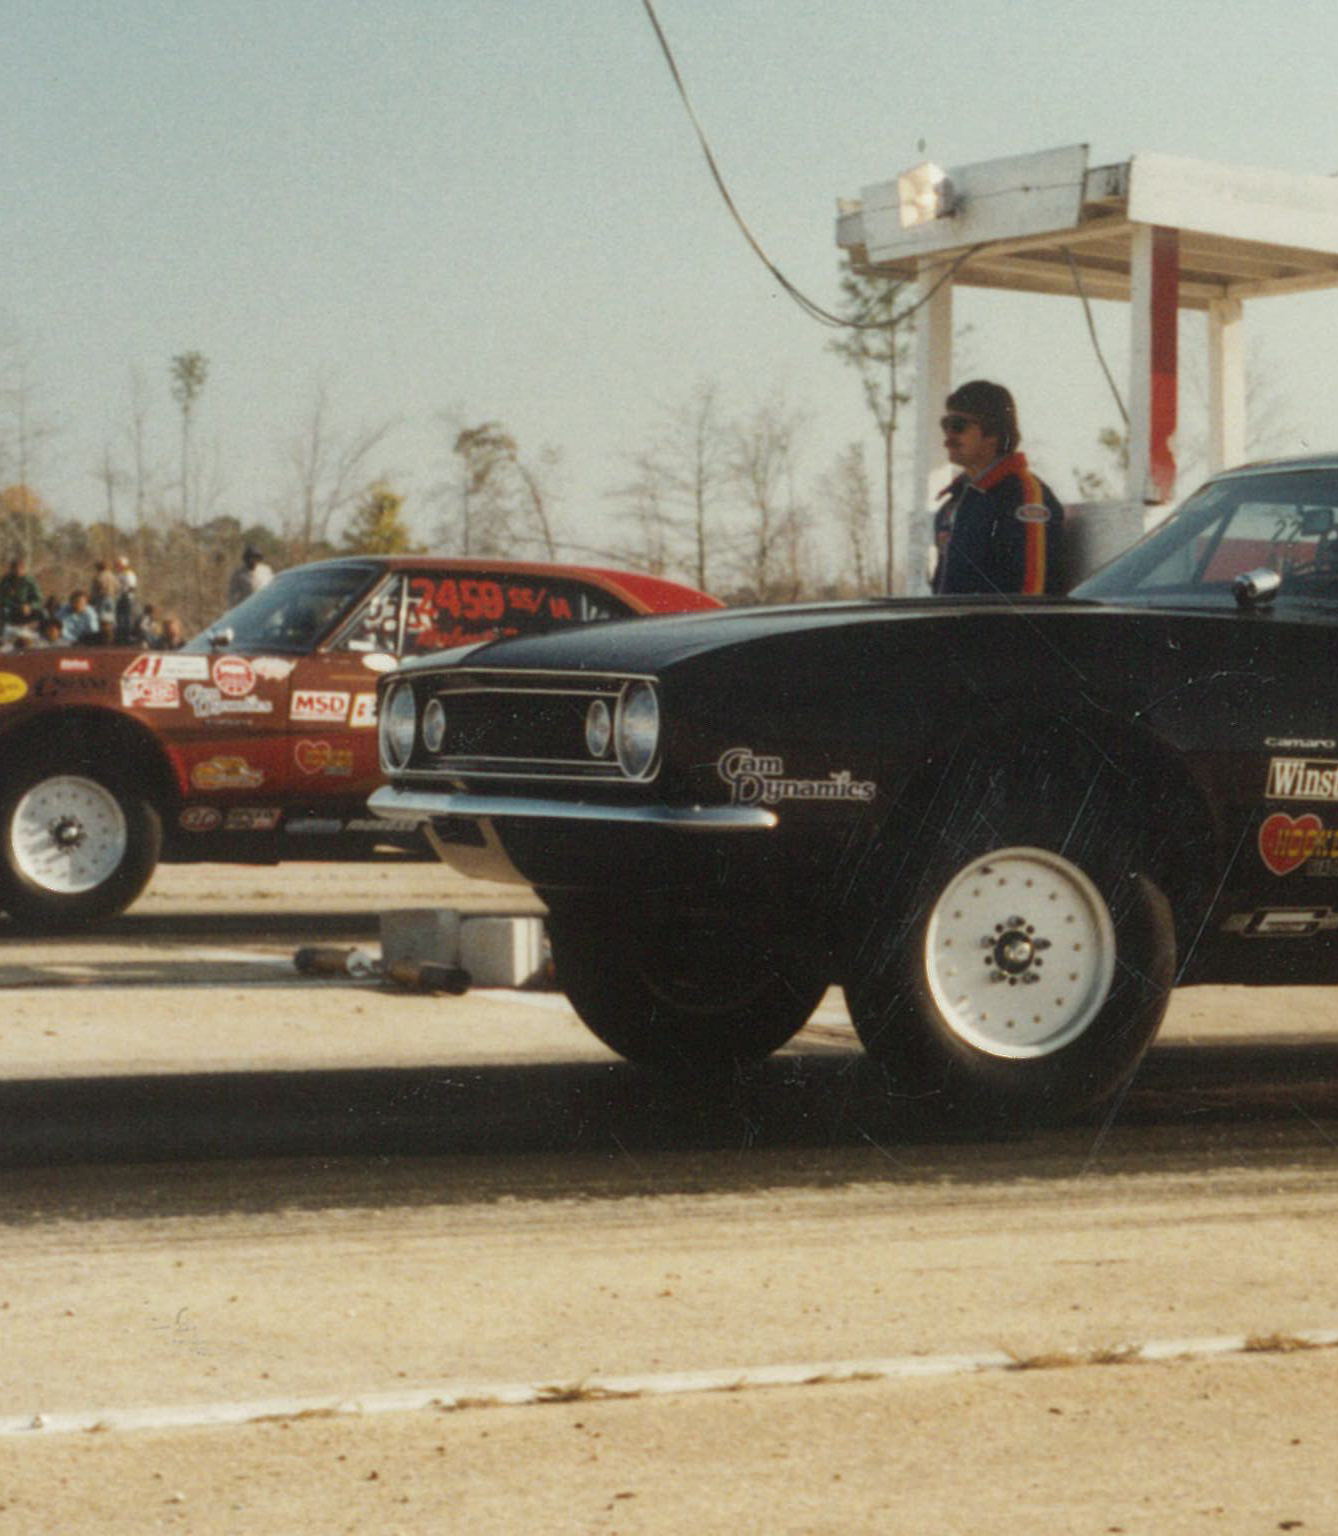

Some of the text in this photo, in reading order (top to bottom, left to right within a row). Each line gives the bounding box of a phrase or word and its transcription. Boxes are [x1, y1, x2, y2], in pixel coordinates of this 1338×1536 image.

[294, 695, 345, 713] MSD
[717, 747, 785, 784] Cam
[732, 772, 877, 807] Dynamics
